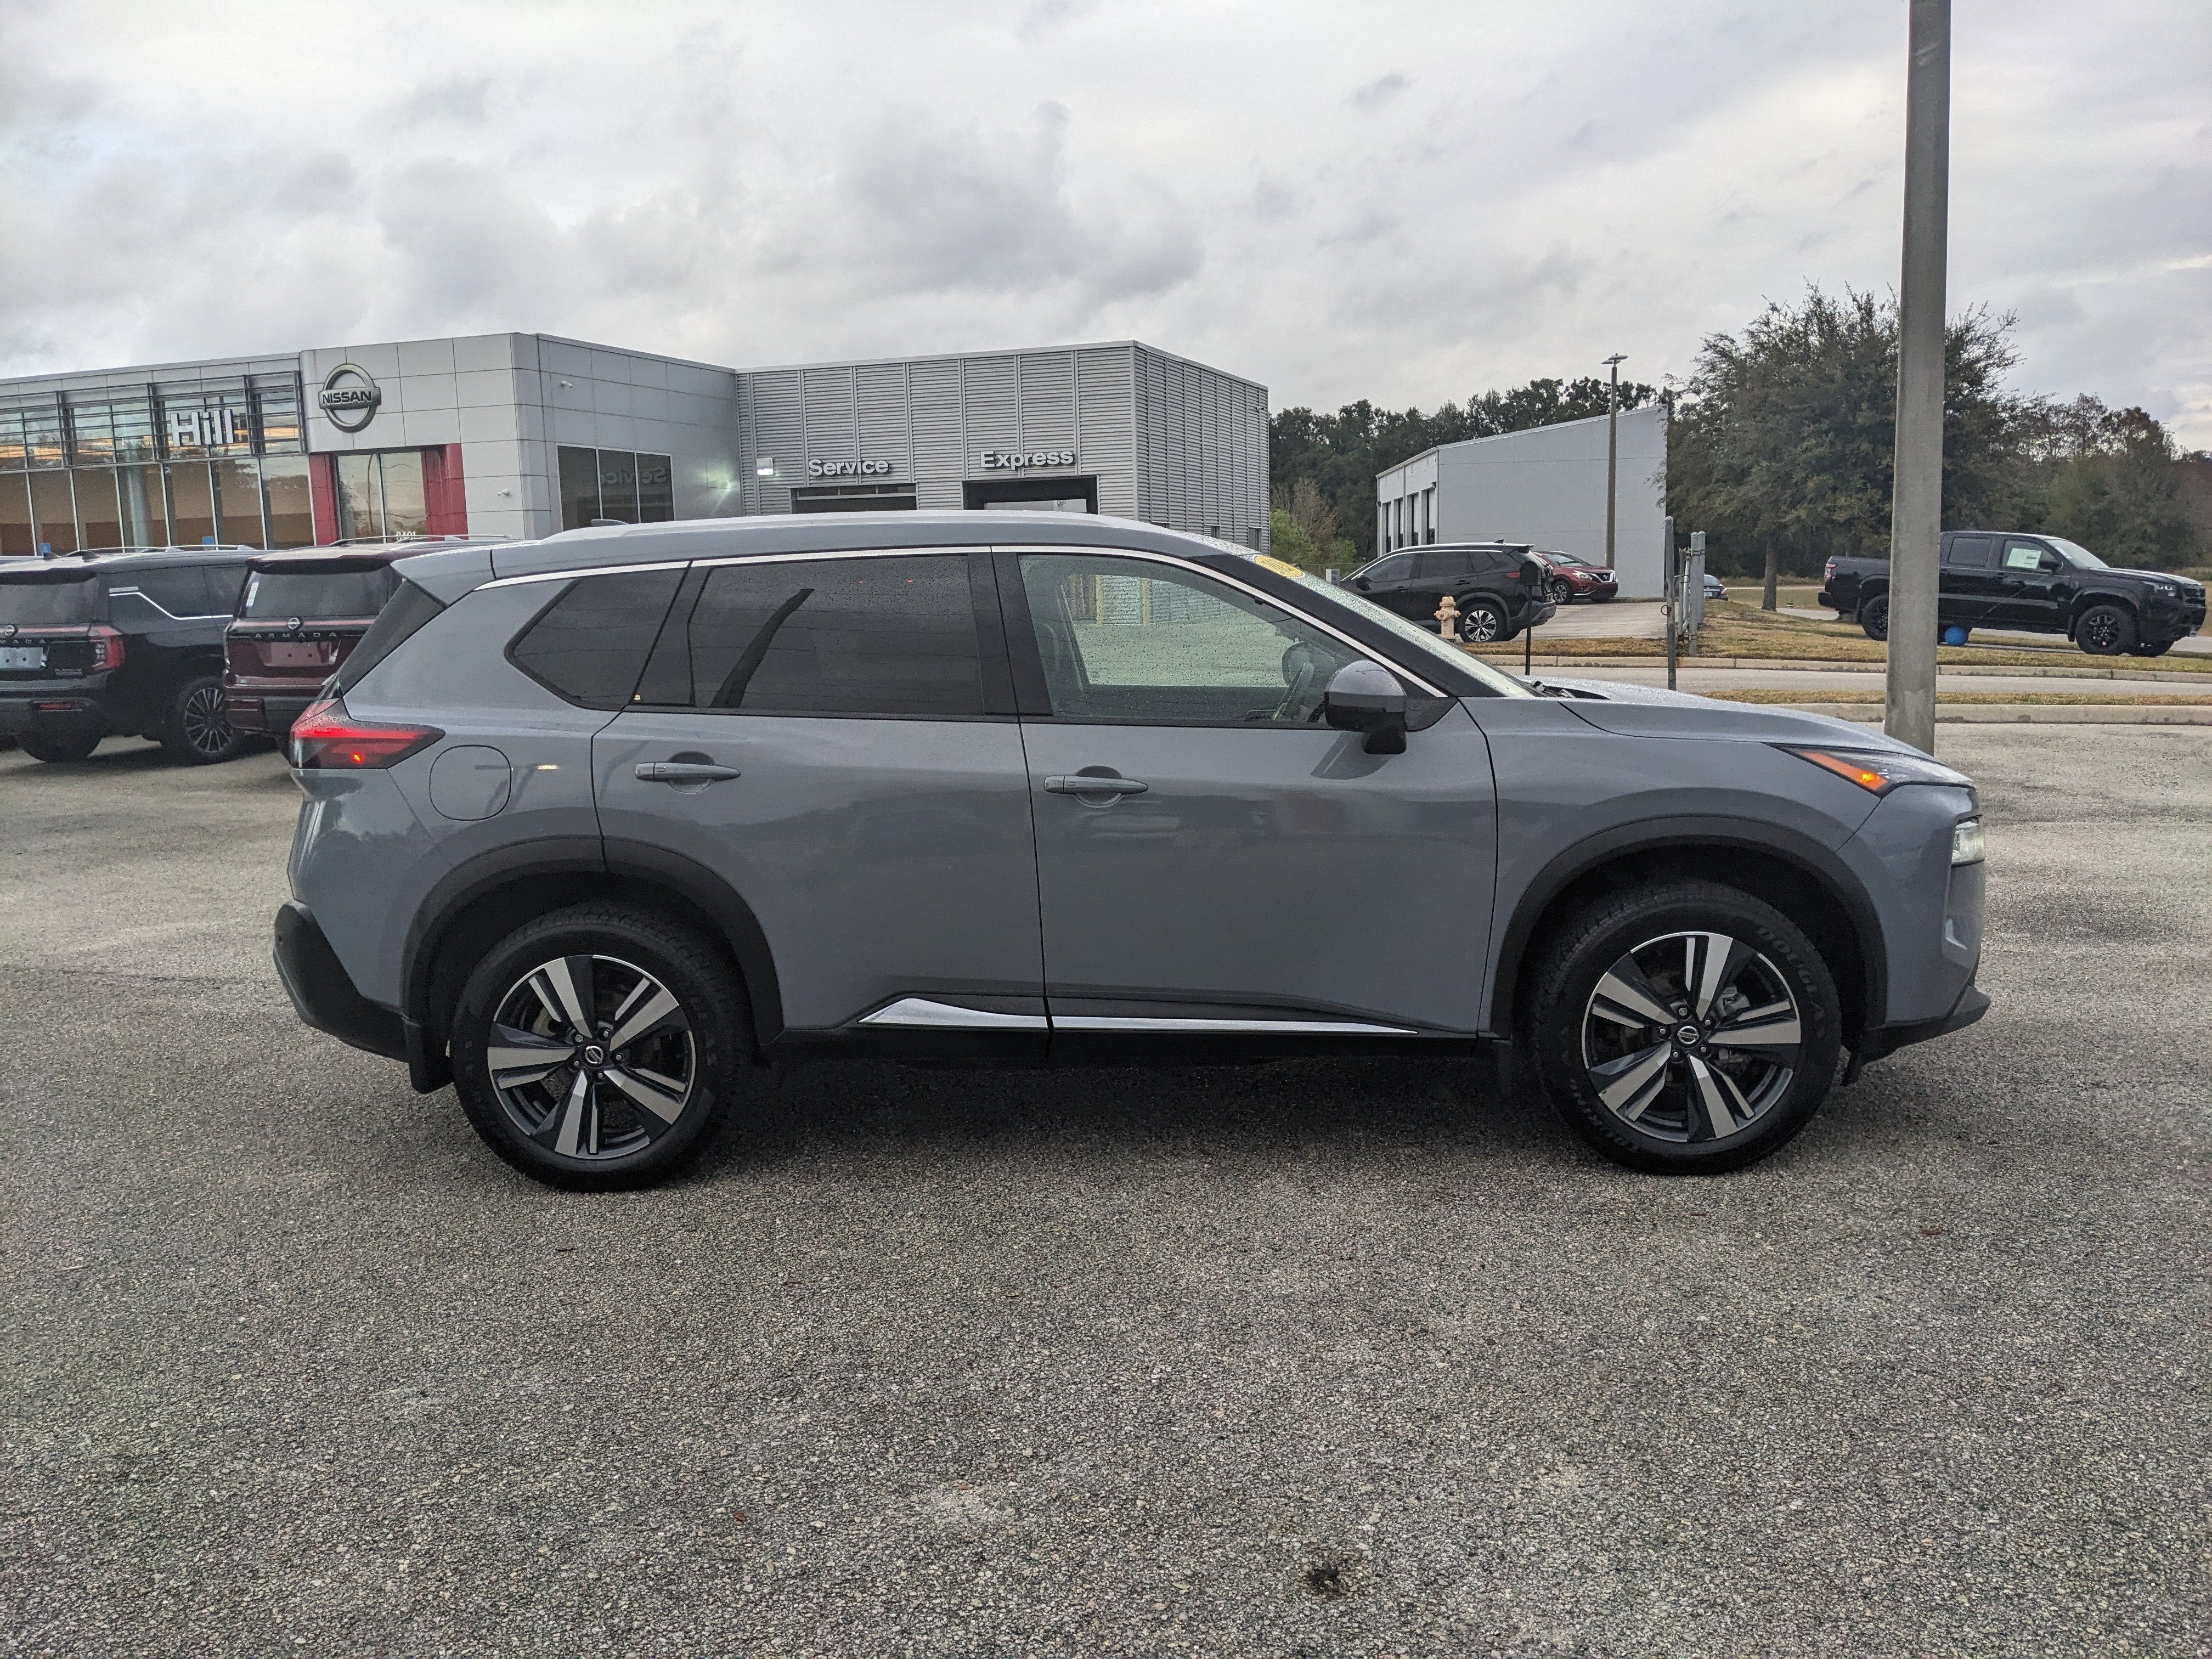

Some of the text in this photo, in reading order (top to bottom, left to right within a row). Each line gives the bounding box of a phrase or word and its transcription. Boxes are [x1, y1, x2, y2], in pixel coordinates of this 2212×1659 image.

[322, 391, 372, 404] NISSAN
[170, 409, 234, 447] Hill
[809, 450, 1074, 476] Service Express
